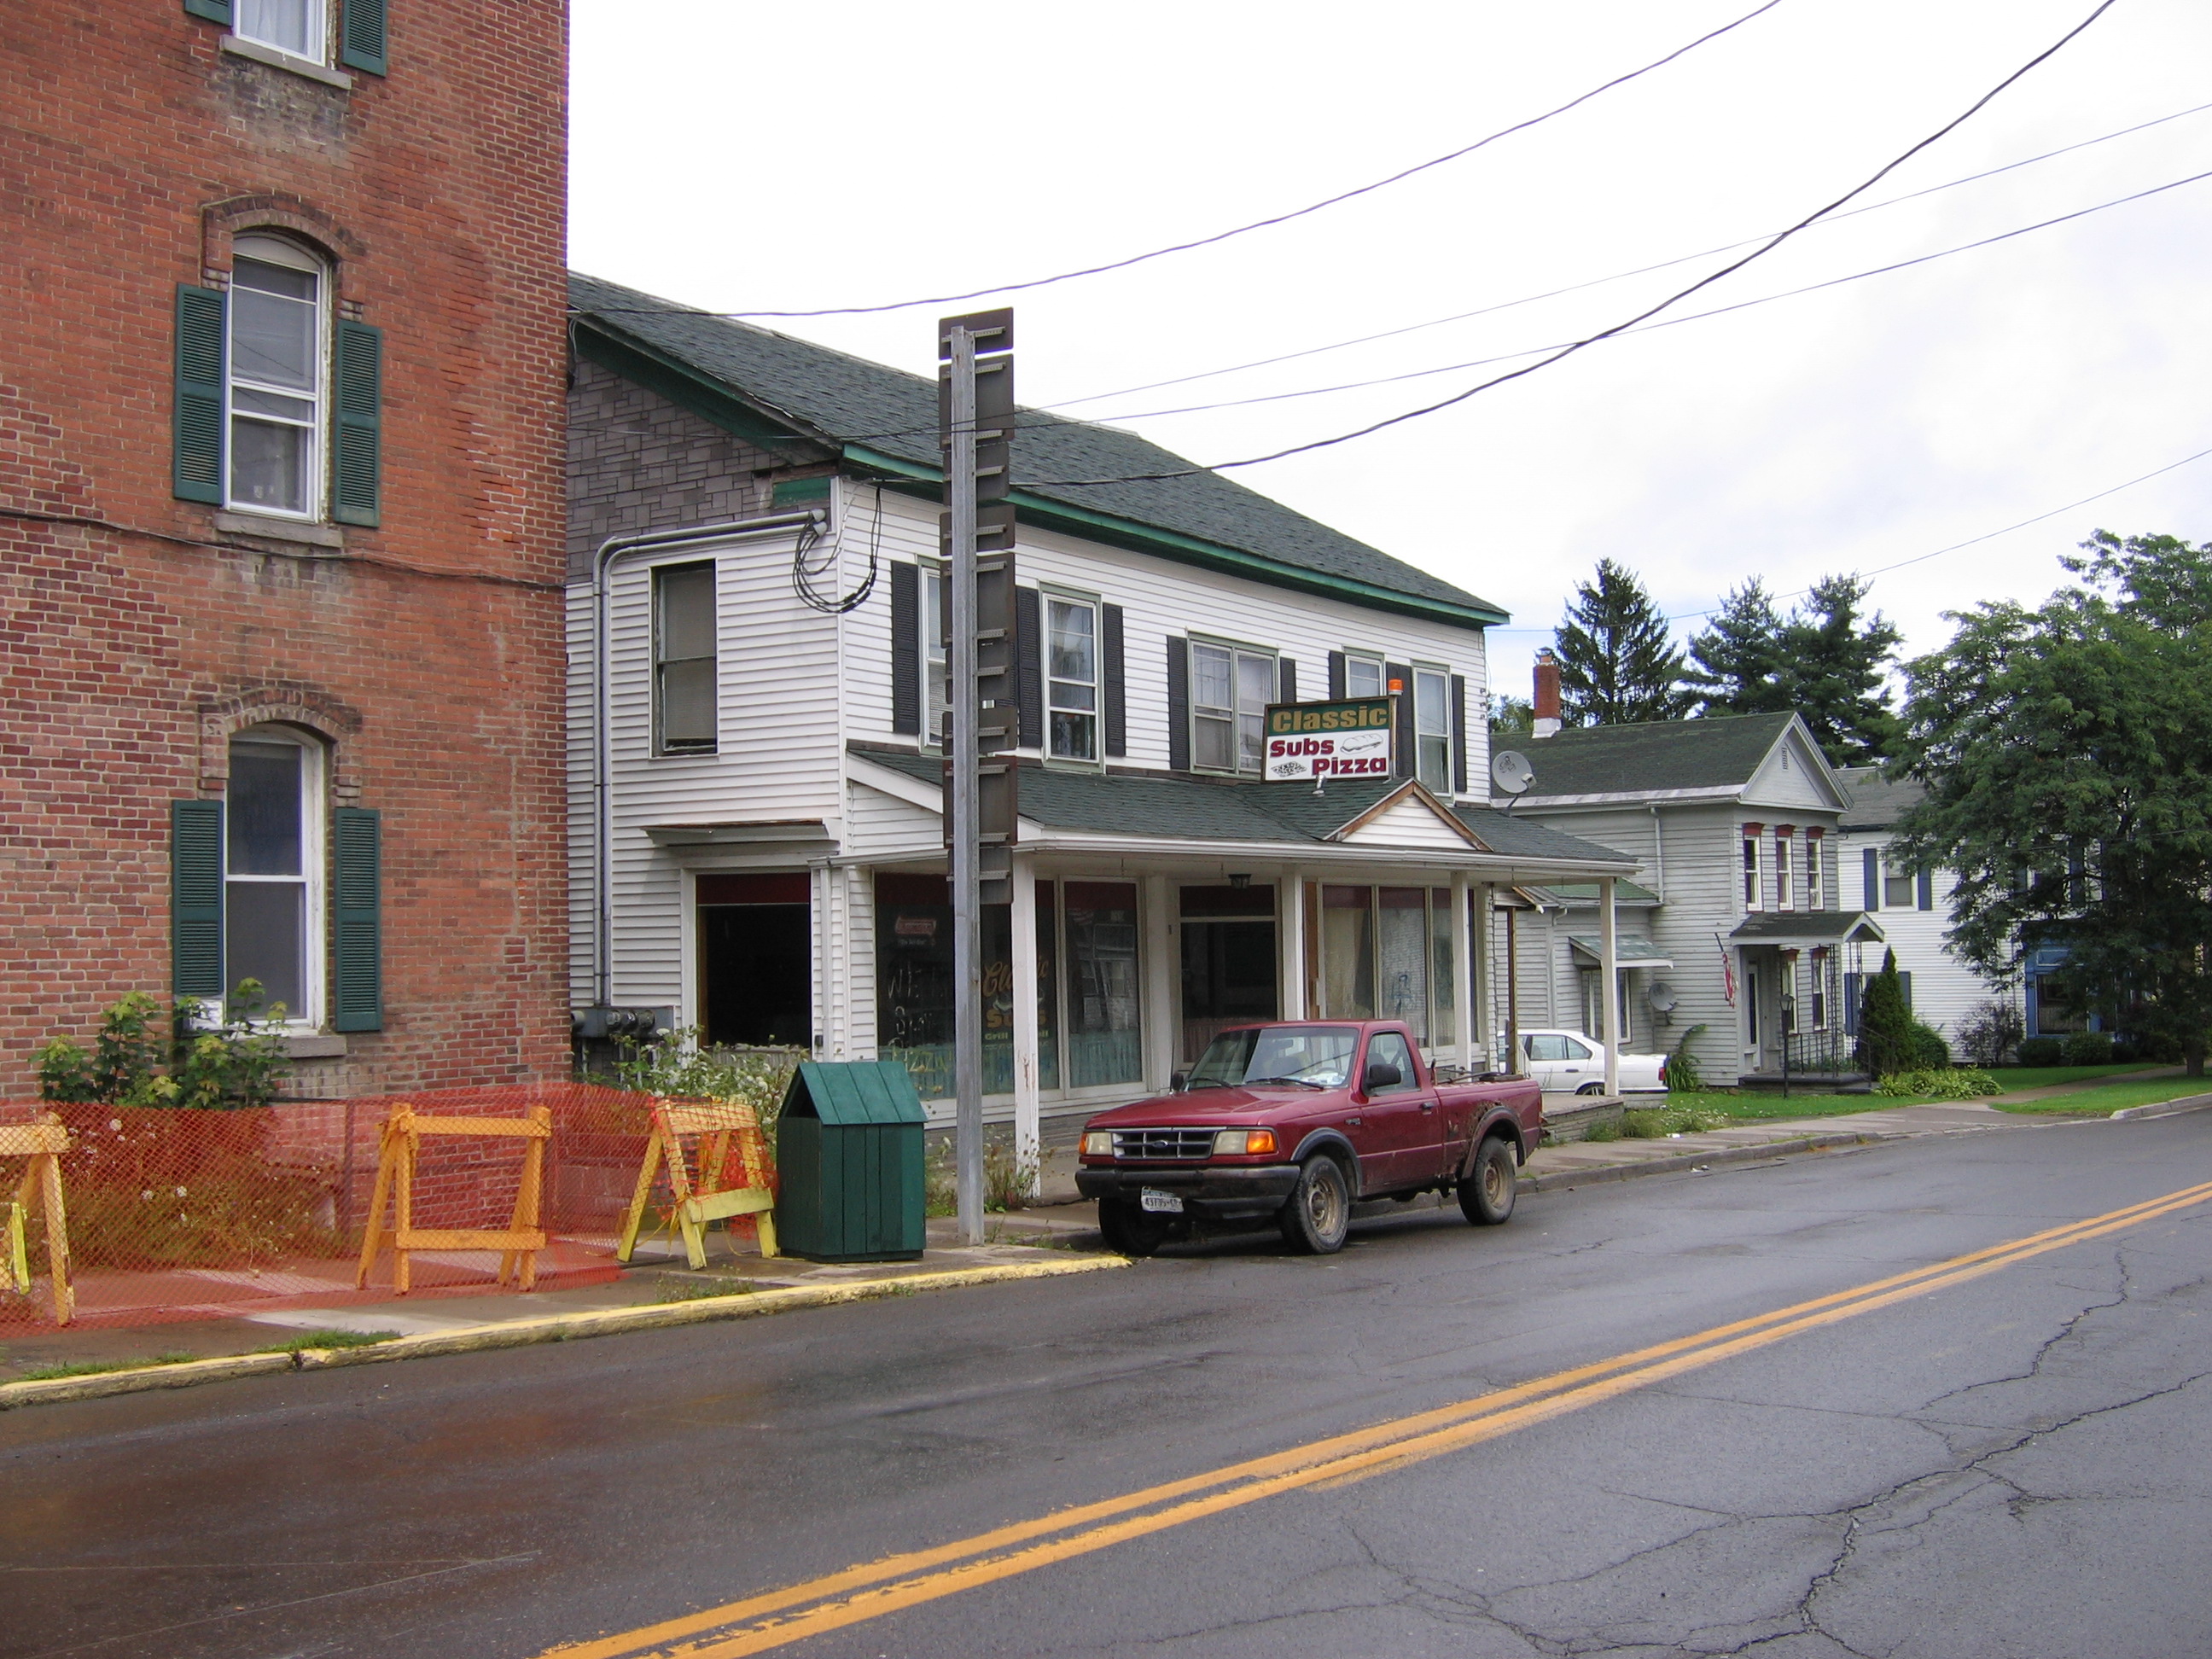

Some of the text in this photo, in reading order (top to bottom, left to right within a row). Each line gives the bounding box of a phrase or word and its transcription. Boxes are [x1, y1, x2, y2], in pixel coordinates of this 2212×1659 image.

[1272, 706, 1387, 733] Classic
[1270, 738, 1335, 758] Subs
[1312, 757, 1387, 777] Pizza
[985, 1032, 1009, 1040] Grill
